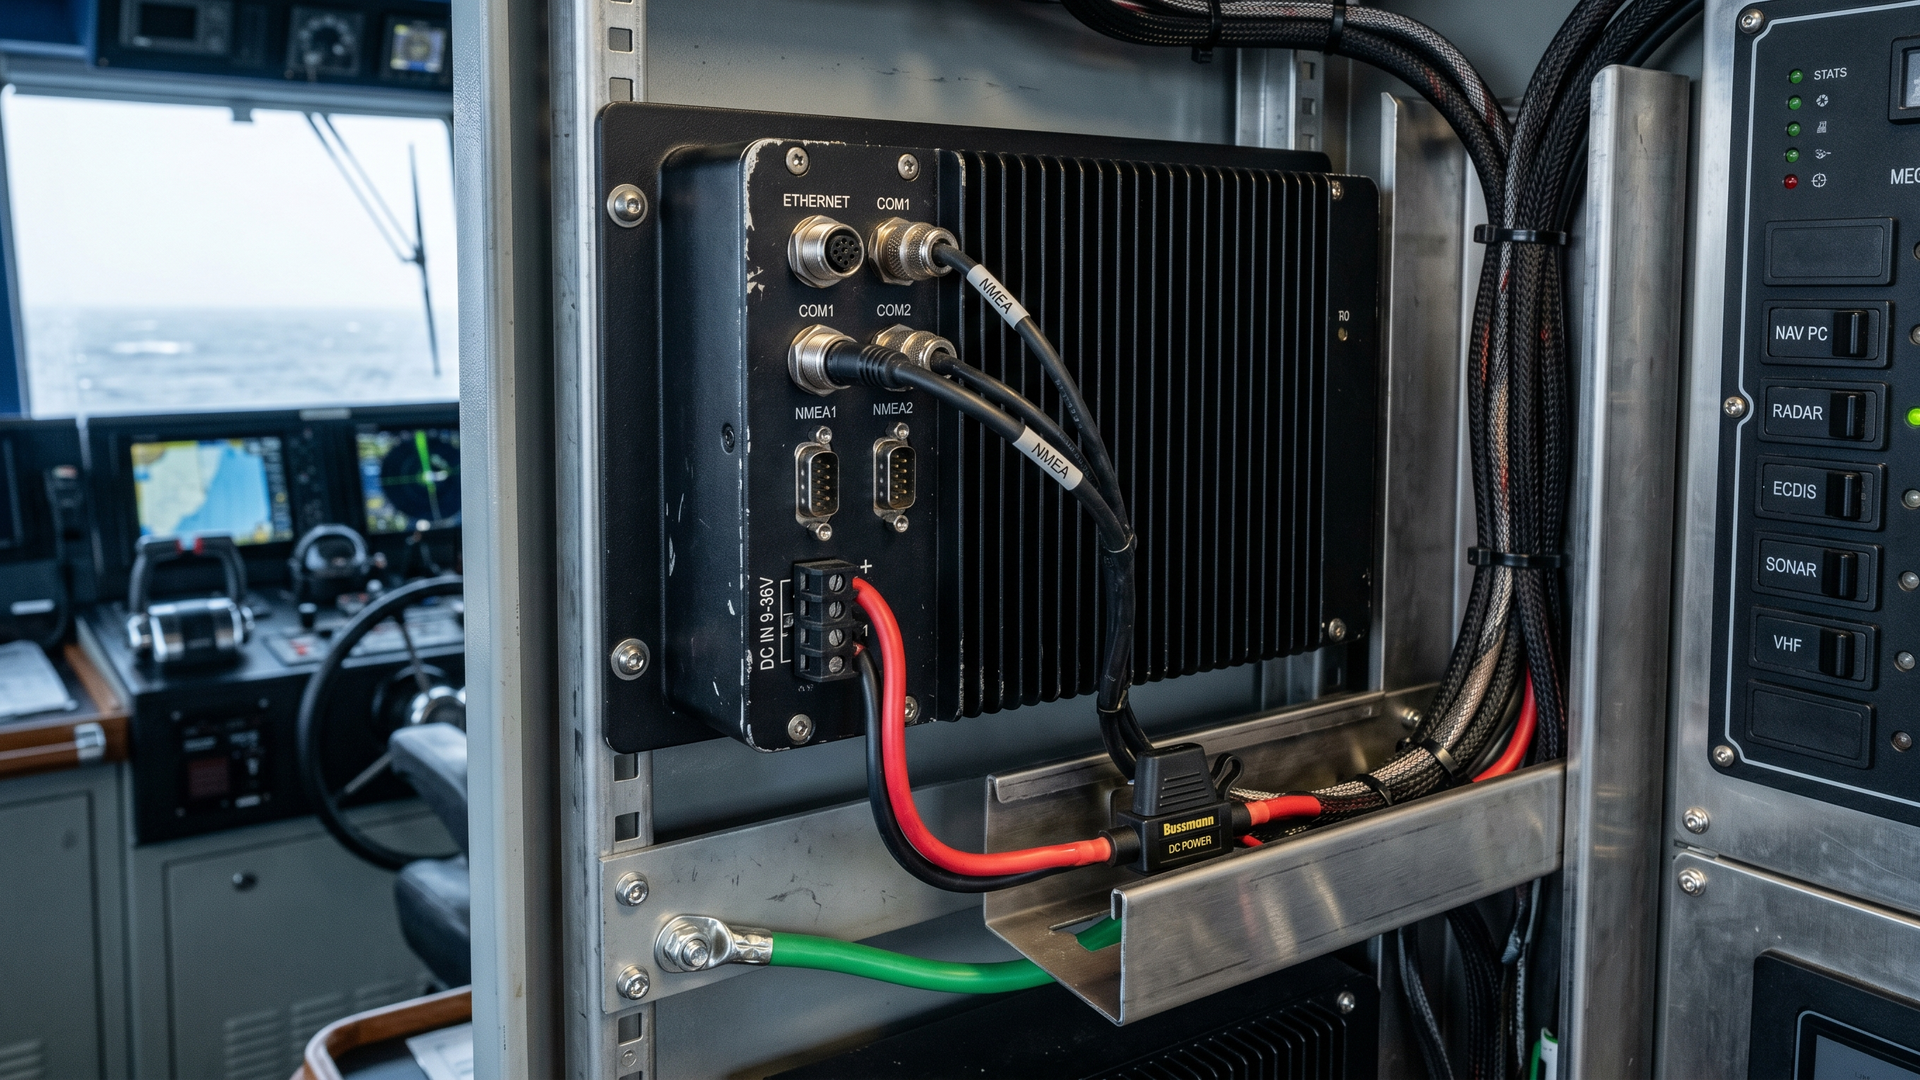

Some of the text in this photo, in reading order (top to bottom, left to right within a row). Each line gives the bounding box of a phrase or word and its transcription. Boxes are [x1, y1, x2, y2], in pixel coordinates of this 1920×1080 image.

[1814, 67, 1847, 80] STATS
[783, 193, 850, 209] ETHERNET
[876, 197, 910, 211] COM1
[978, 277, 1014, 315] NMEA
[798, 304, 834, 318] COM1
[876, 303, 911, 317] COM2
[1775, 325, 1828, 341] NAV PC
[795, 406, 837, 420] NMEA1
[872, 402, 914, 416] NMEA2
[1772, 403, 1823, 421] RADAR
[1031, 442, 1070, 480] NMEA
[1773, 480, 1817, 500] ECDIS
[1765, 556, 1817, 578] SONAR
[759, 576, 775, 670] DC IN 9-36V
[1773, 634, 1802, 653] VHF
[1164, 816, 1214, 836] Bussmann
[1169, 836, 1212, 854] DC POWER
